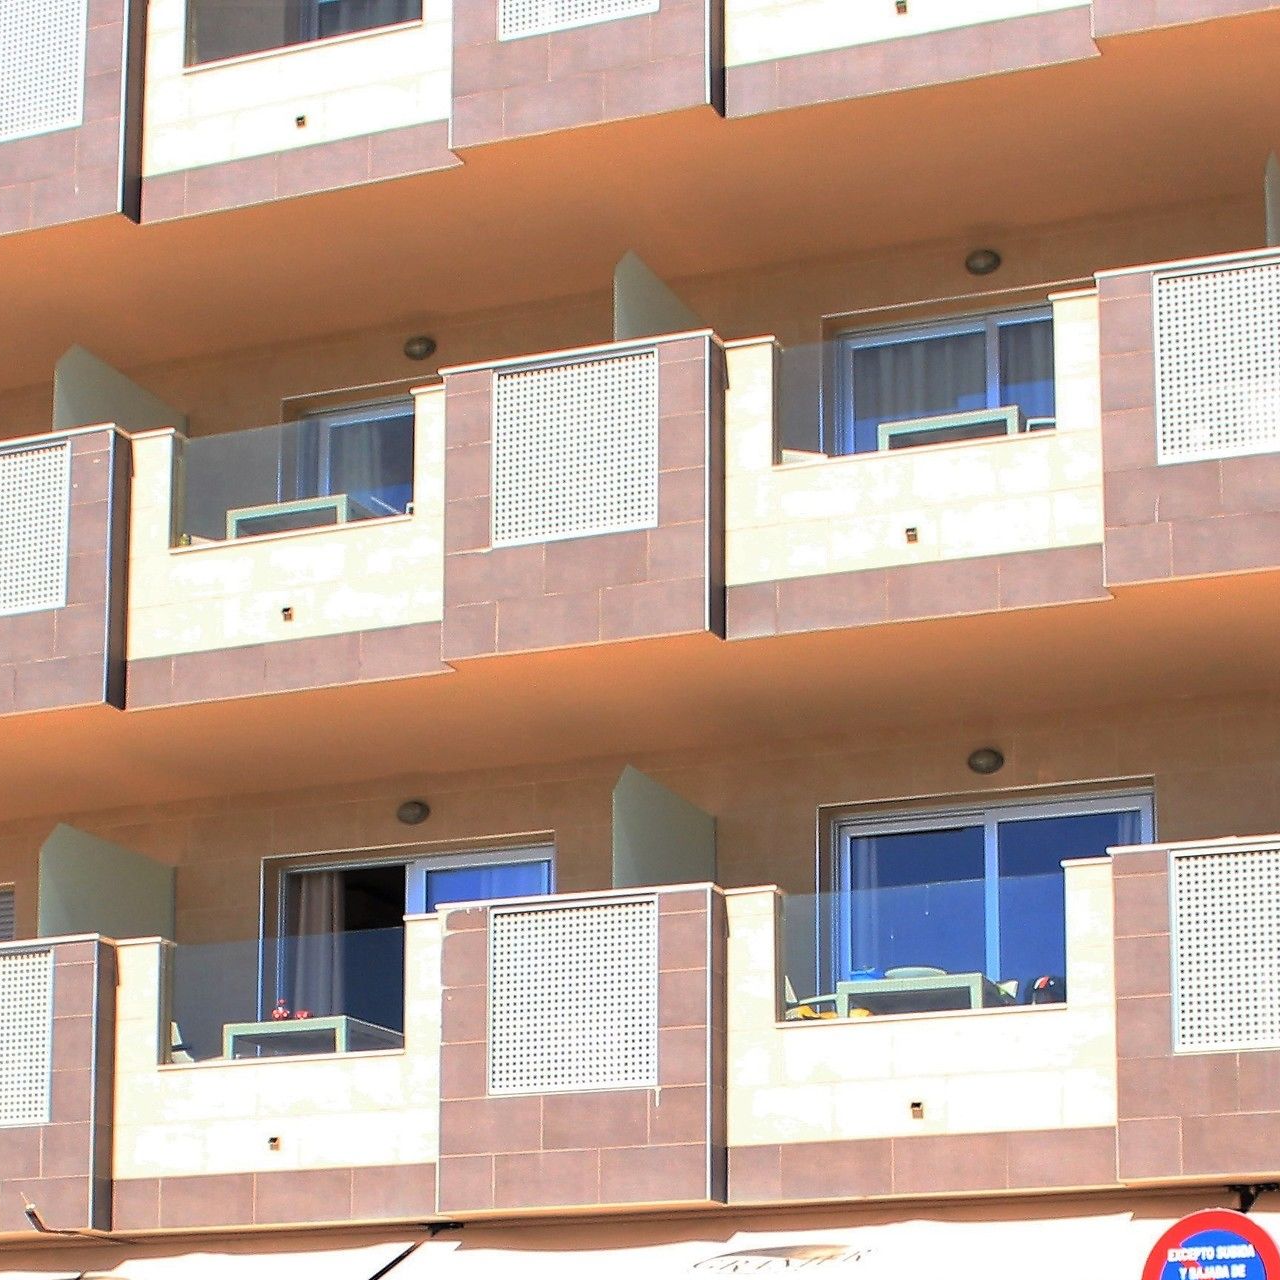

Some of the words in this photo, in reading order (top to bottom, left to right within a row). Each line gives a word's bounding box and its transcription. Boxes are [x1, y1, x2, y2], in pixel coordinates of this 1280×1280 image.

[1168, 1247, 1215, 1262] EXCEPTO
[1178, 1267, 1188, 1280] Y
[1230, 1264, 1246, 1278] DE
